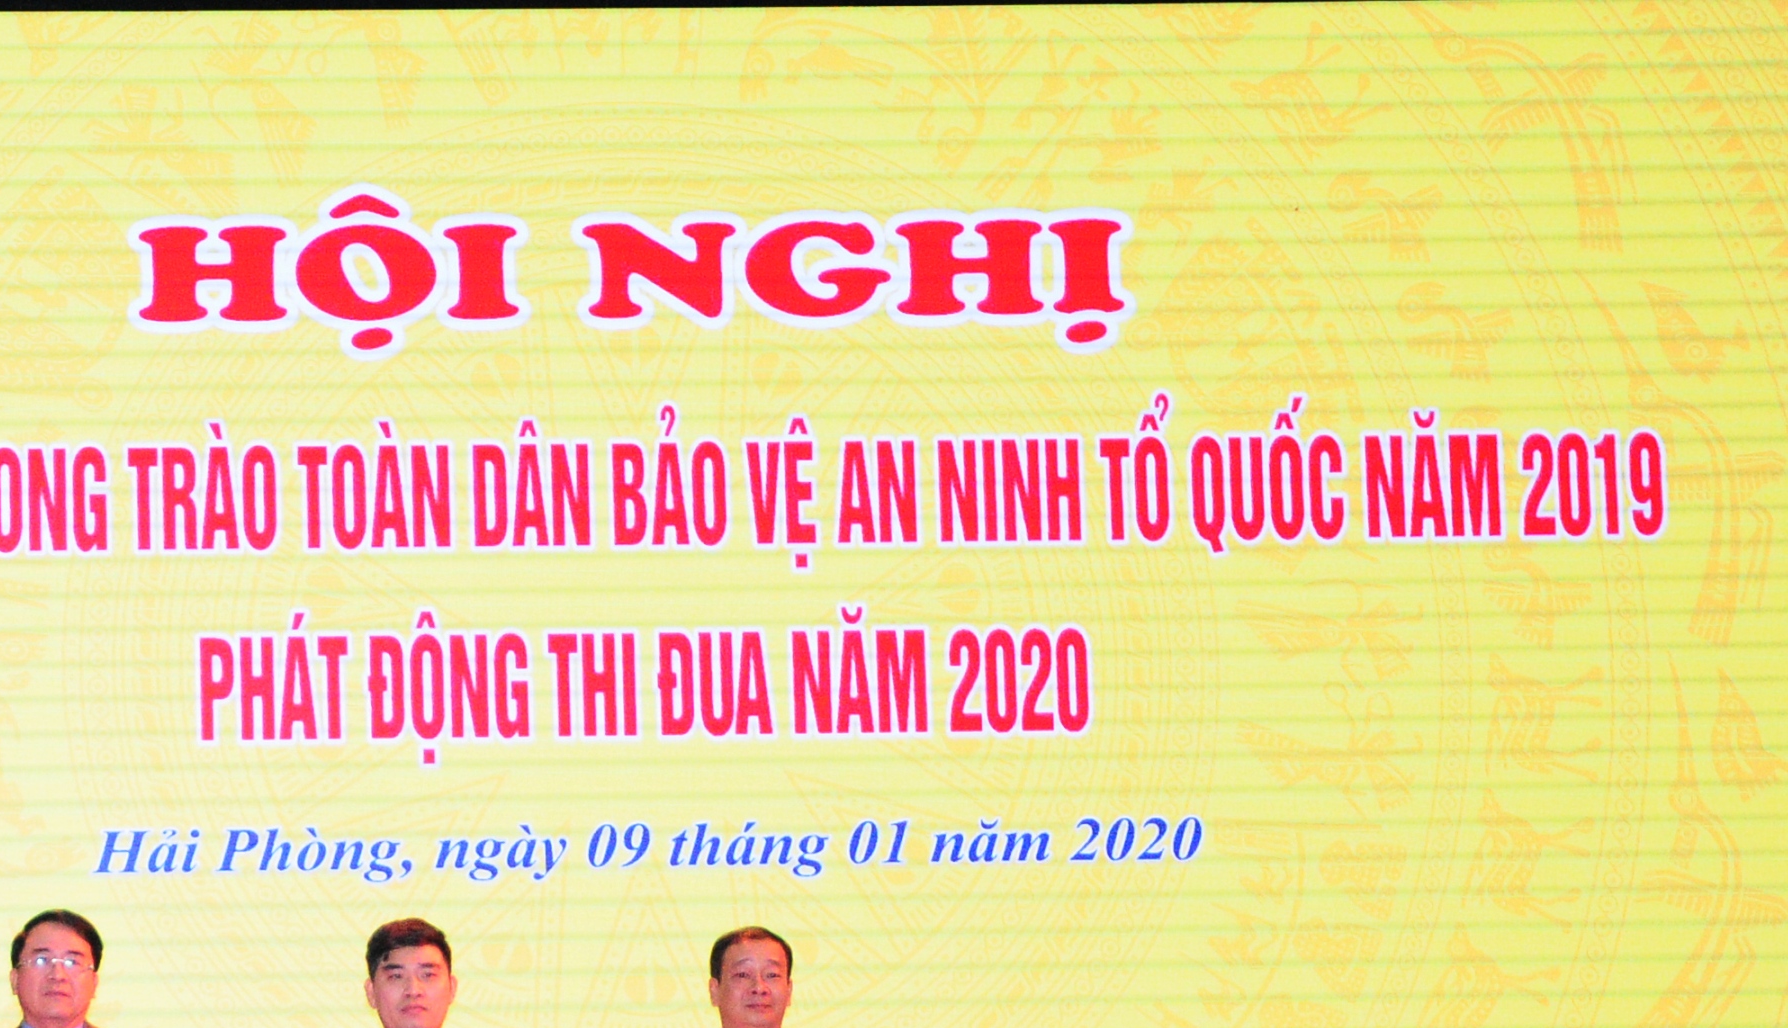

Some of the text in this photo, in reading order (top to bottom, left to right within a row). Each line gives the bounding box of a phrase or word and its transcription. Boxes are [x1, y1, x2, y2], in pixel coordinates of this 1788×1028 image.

[138, 193, 1126, 350] HỘI NGHỊ
[128, 421, 276, 551] TRÀO
[297, 420, 450, 550] TOÀN
[471, 419, 591, 547] DÂN
[613, 406, 725, 546] BẢO
[747, 418, 813, 567] VỆ
[838, 440, 918, 543] AN
[938, 436, 1082, 542] NINH
[1099, 395, 1170, 540] TỔ
[1192, 397, 1345, 554] QUỐC
[1365, 412, 1501, 538] NĂM
[1522, 431, 1664, 537] 2019
[199, 608, 1088, 765] PHÁT ĐỘNG THI ĐUA NĂM 2020
[93, 819, 1202, 883] Hải Phòng, ngày 09 tháng 01 năm 2020
